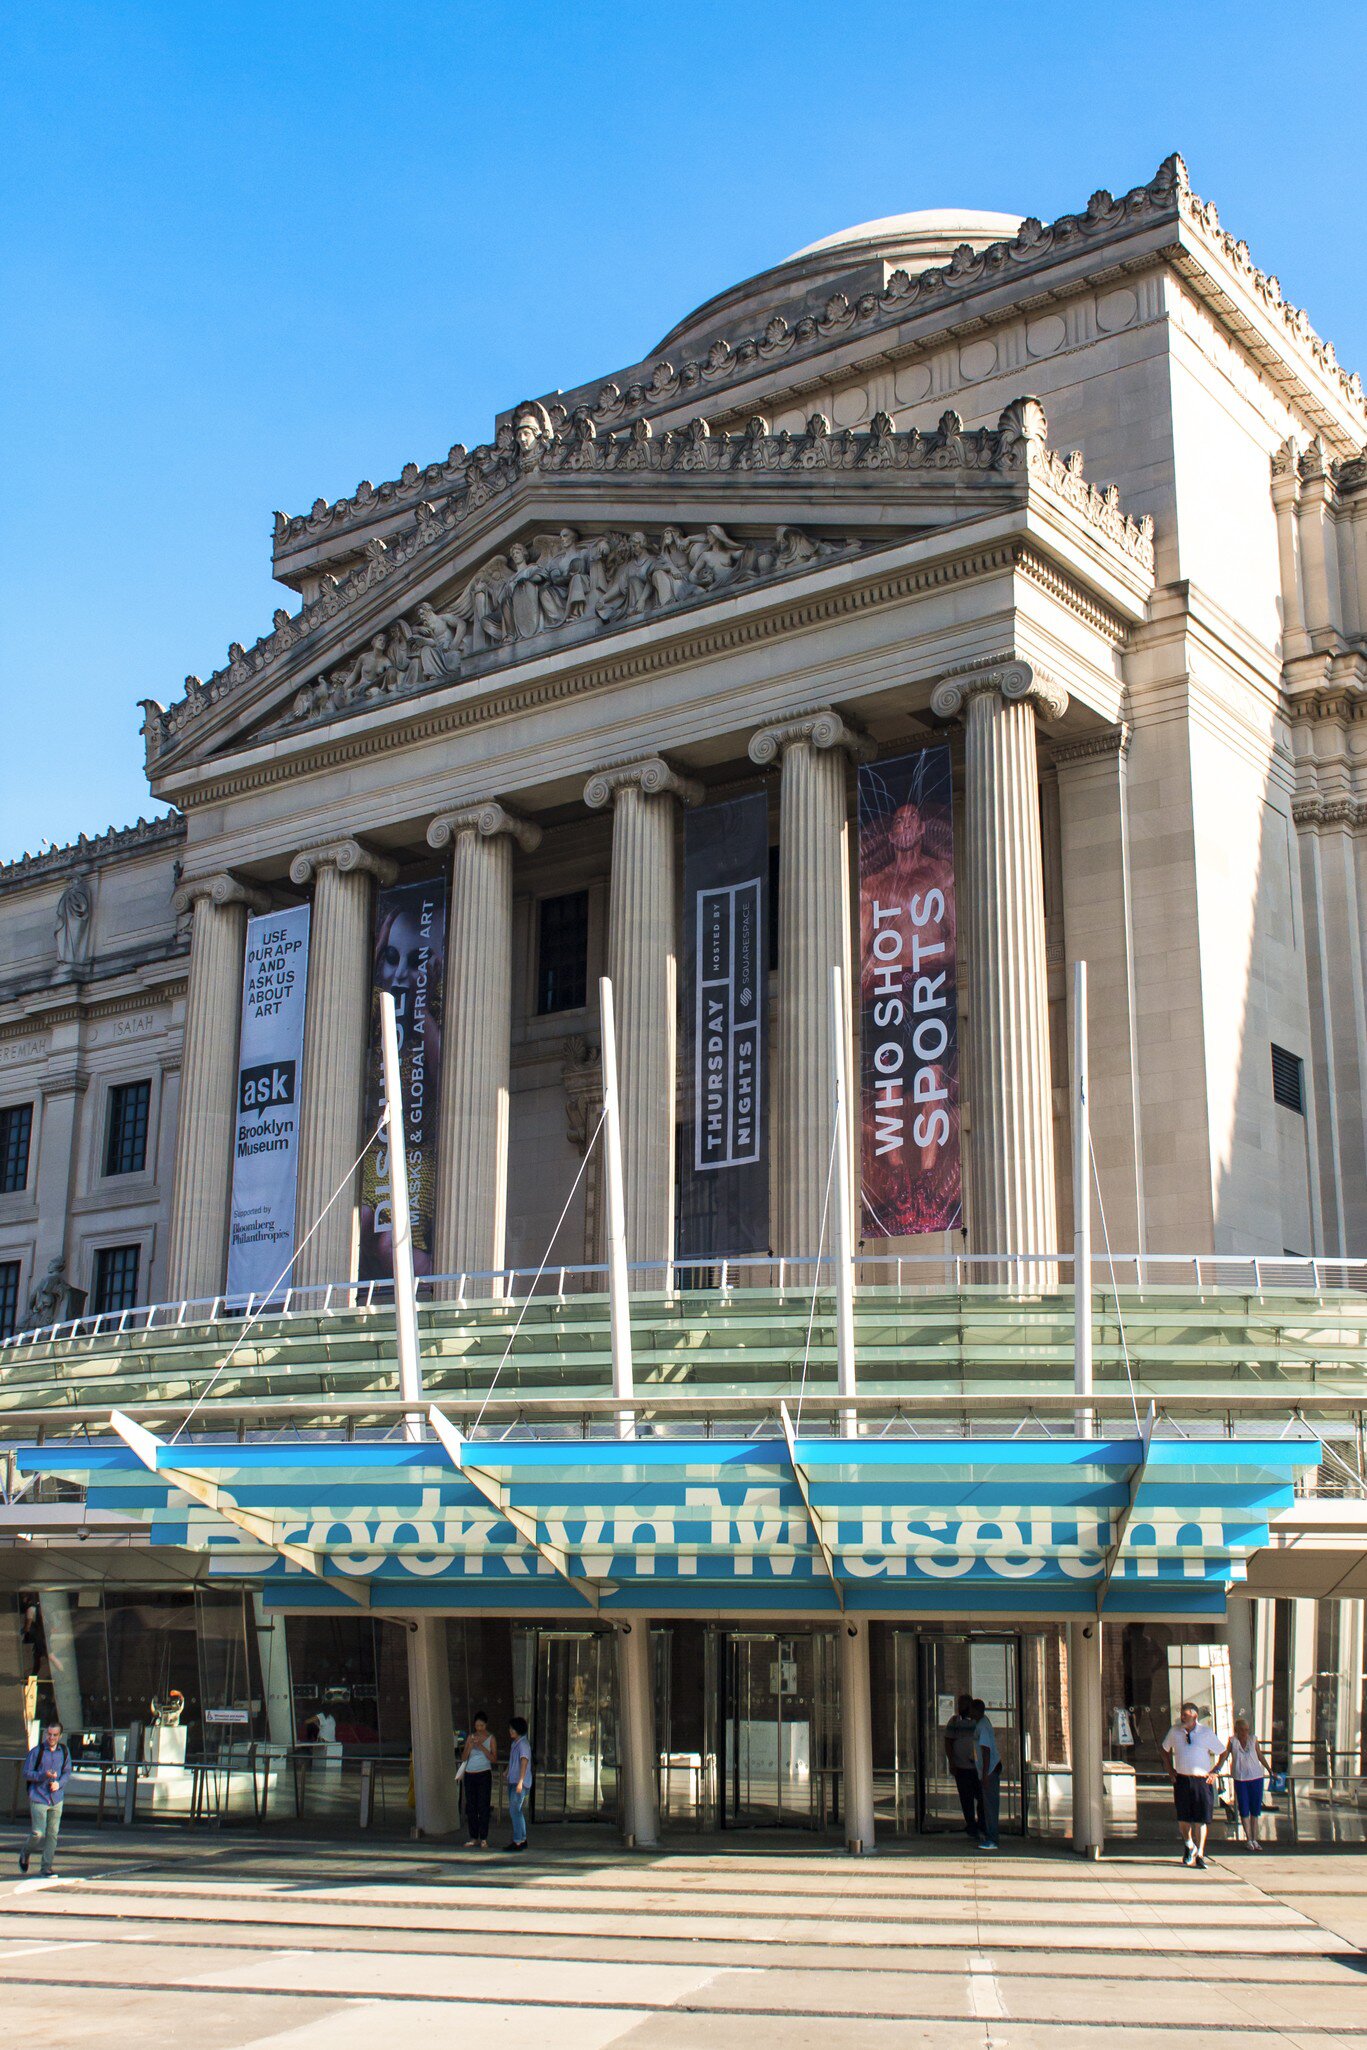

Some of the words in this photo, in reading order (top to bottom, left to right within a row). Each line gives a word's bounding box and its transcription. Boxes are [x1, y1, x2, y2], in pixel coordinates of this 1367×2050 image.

[419, 900, 434, 938] ART
[713, 904, 720, 918] BY
[263, 929, 287, 946] USE
[742, 902, 750, 984] SQUARESPACE
[248, 947, 273, 963] OUR
[275, 940, 302, 957] APP
[258, 958, 285, 974] AND
[873, 900, 904, 1027] SHOT
[248, 974, 273, 991] ASK
[276, 970, 295, 985] US
[413, 947, 430, 1033] AFRICAN
[248, 985, 293, 1006] ABOUT
[255, 1001, 282, 1018] ART
[910, 887, 950, 1148] SPORTS
[112, 1016, 154, 1038] ISAIAH
[410, 1040, 425, 1123] GLOBAL
[707, 1000, 723, 1150] THURSDAY
[244, 1068, 289, 1106] ask
[738, 1041, 752, 1145] NIGHTS
[874, 1041, 904, 1156] WHO
[238, 1119, 294, 1141] Brooklyn
[409, 1129, 422, 1143] &
[237, 1138, 289, 1158] Museum
[409, 1150, 422, 1226] MASKS
[234, 1206, 262, 1218] Supported
[263, 1206, 272, 1215] by
[232, 1229, 290, 1245] Philanthropies
[233, 1219, 275, 1234] Bloomberg
[166, 1487, 699, 1597] Brooklyn
[684, 1487, 1248, 1579] Museum
